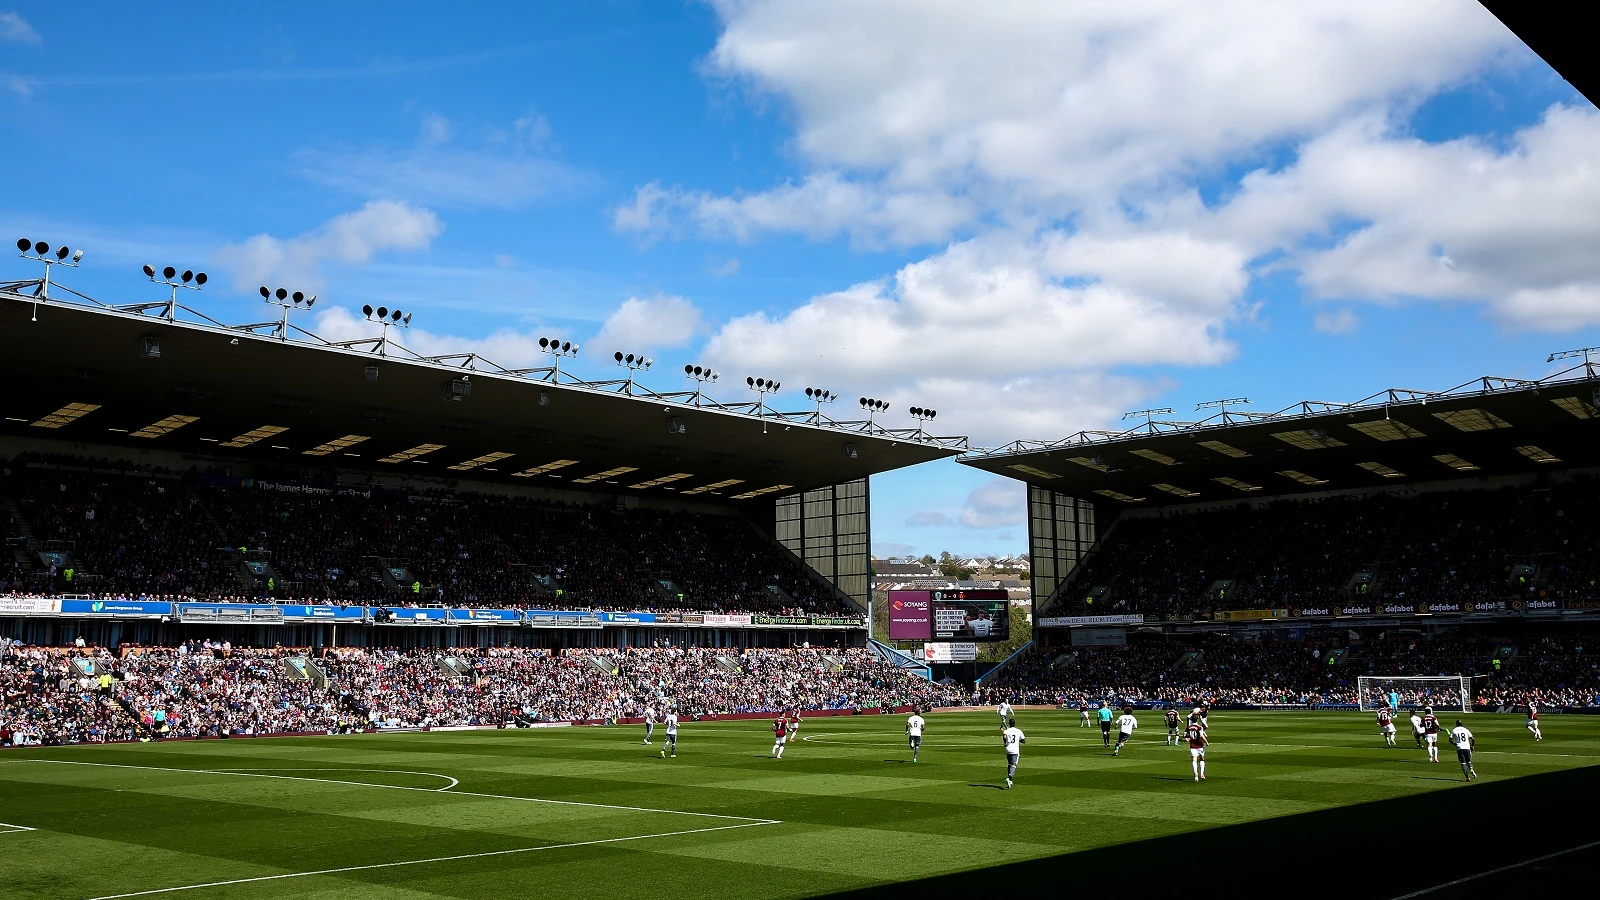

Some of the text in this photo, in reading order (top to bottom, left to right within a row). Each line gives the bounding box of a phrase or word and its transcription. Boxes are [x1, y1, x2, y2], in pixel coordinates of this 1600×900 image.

[257, 481, 371, 498] The James Hargrees Stad
[1343, 606, 1371, 615] dafabet
[1385, 605, 1414, 613] dafabet
[1429, 603, 1459, 612] dafabet
[1302, 608, 1329, 616] dafabet
[705, 614, 727, 622] Burnley
[729, 615, 750, 623] Burnley
[1166, 613, 1196, 621] Hollnds
[777, 721, 782, 730] 7
[1122, 718, 1131, 726] 27
[1457, 732, 1467, 742] 18
